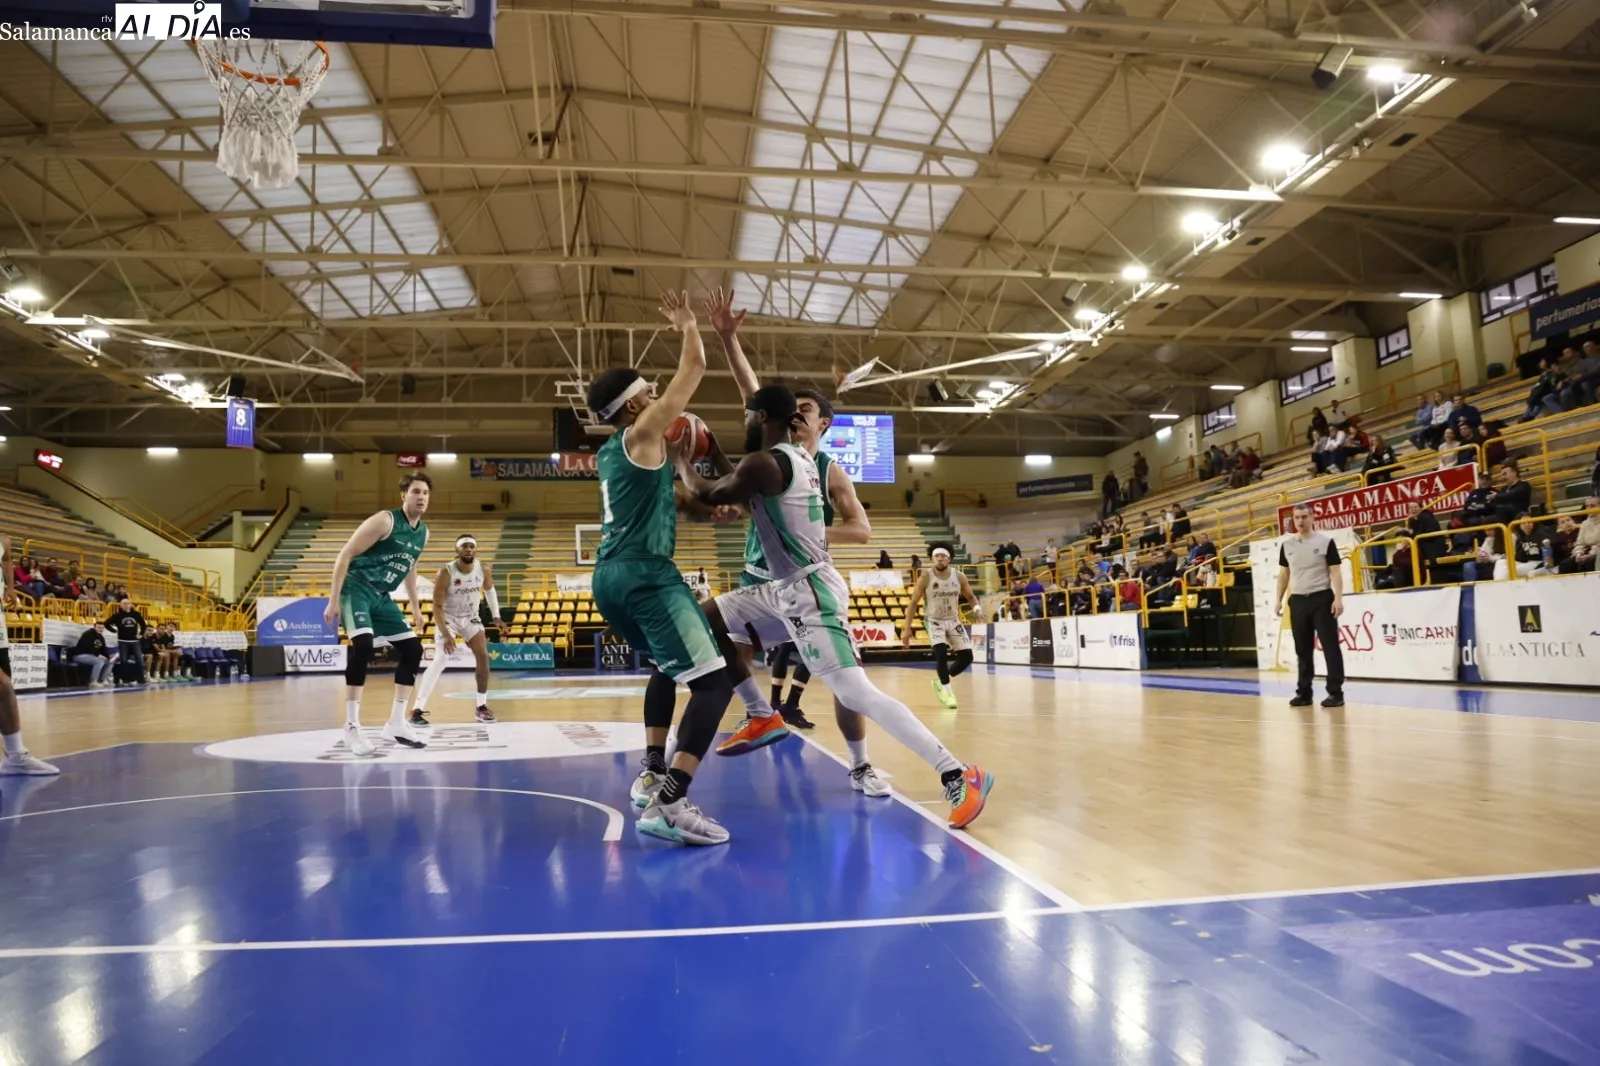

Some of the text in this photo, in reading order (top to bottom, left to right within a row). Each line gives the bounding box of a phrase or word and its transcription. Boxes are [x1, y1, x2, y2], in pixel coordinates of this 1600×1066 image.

[236, 408, 246, 426] 8
[563, 454, 585, 471] LA
[1314, 474, 1447, 518] SALAMANCA
[1359, 508, 1375, 525] DE
[1377, 505, 1392, 523] LA
[286, 649, 333, 665] MyMe
[502, 652, 551, 663] CAJA RURAL
